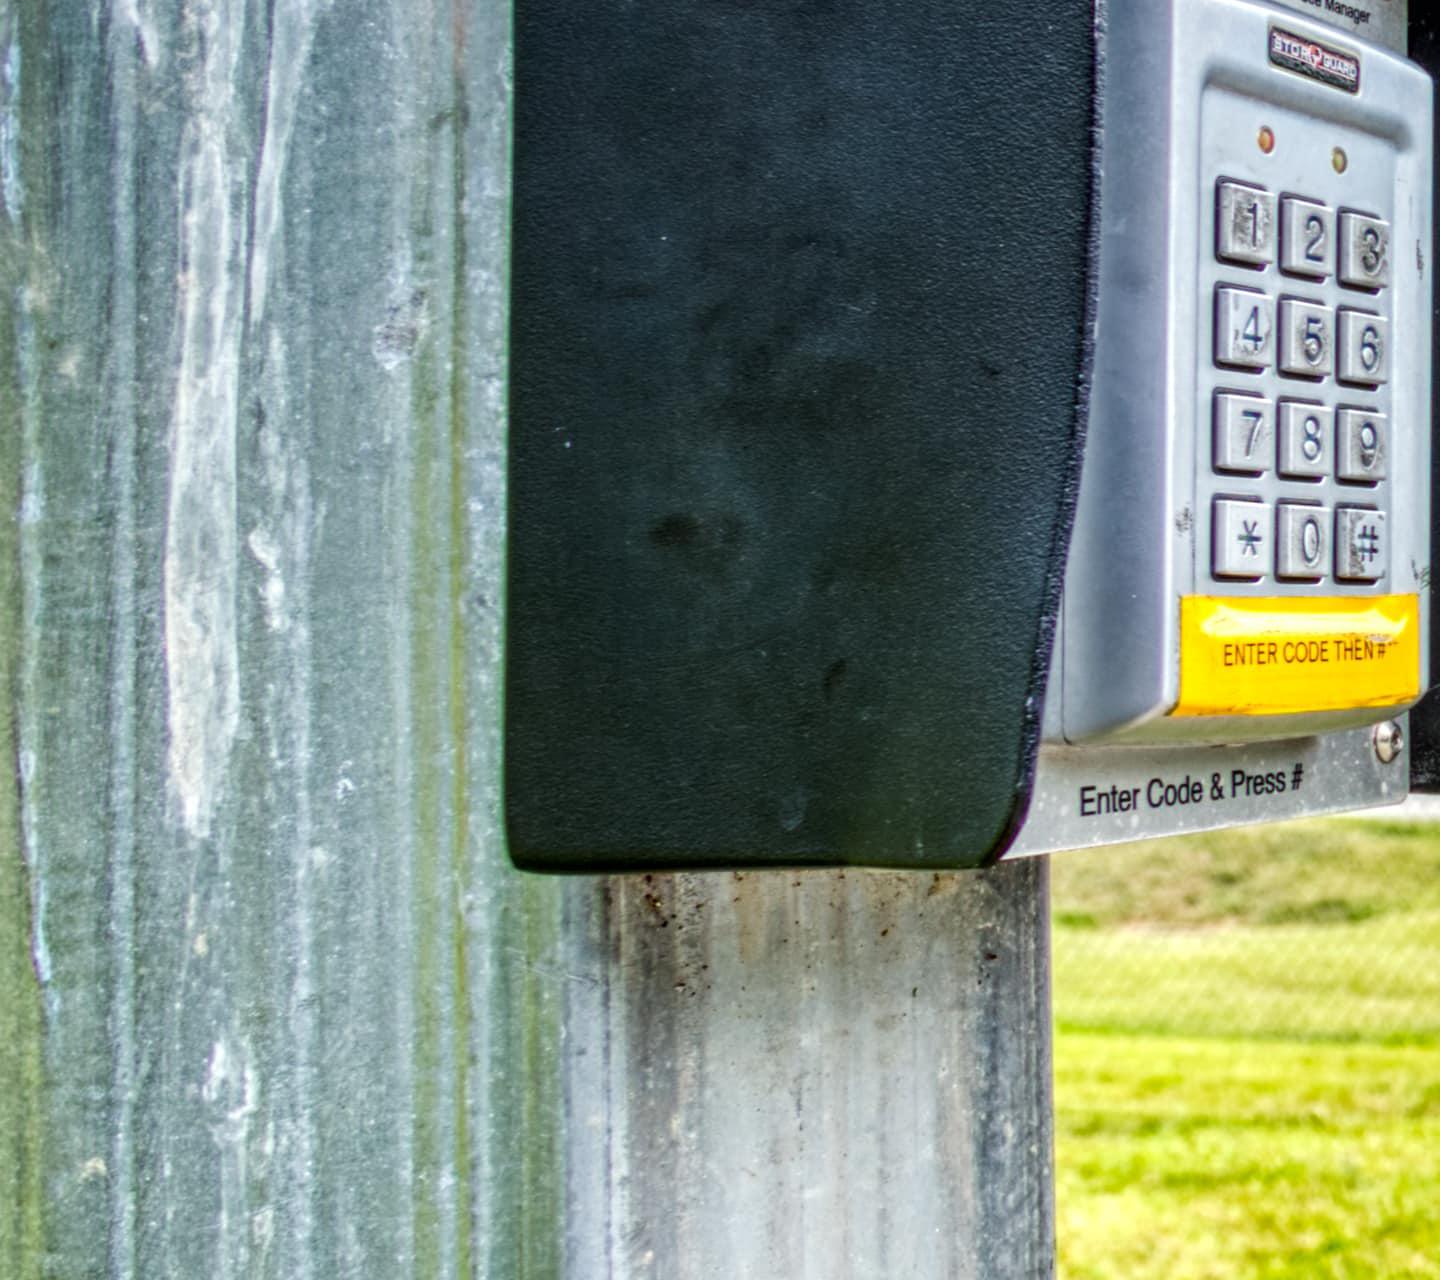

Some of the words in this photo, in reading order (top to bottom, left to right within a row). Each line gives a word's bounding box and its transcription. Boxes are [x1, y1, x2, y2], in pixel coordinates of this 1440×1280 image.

[1304, 214, 1324, 263] 2
[1361, 226, 1382, 275] 3
[1241, 305, 1264, 352] 4
[1303, 317, 1323, 366] 5
[1360, 325, 1380, 372] 6
[1241, 410, 1264, 458] 7
[1302, 415, 1322, 463] 8
[1360, 421, 1379, 470] 9
[1302, 518, 1321, 564] 0
[1358, 523, 1380, 562] #
[1223, 641, 1278, 667] ENTER
[1283, 640, 1330, 664] CODE
[1335, 639, 1374, 662] THEN
[1079, 784, 1140, 817] Enter
[1146, 775, 1204, 808] Code
[1210, 772, 1225, 800] &
[1231, 768, 1287, 798] Press
[1291, 763, 1304, 791] #
